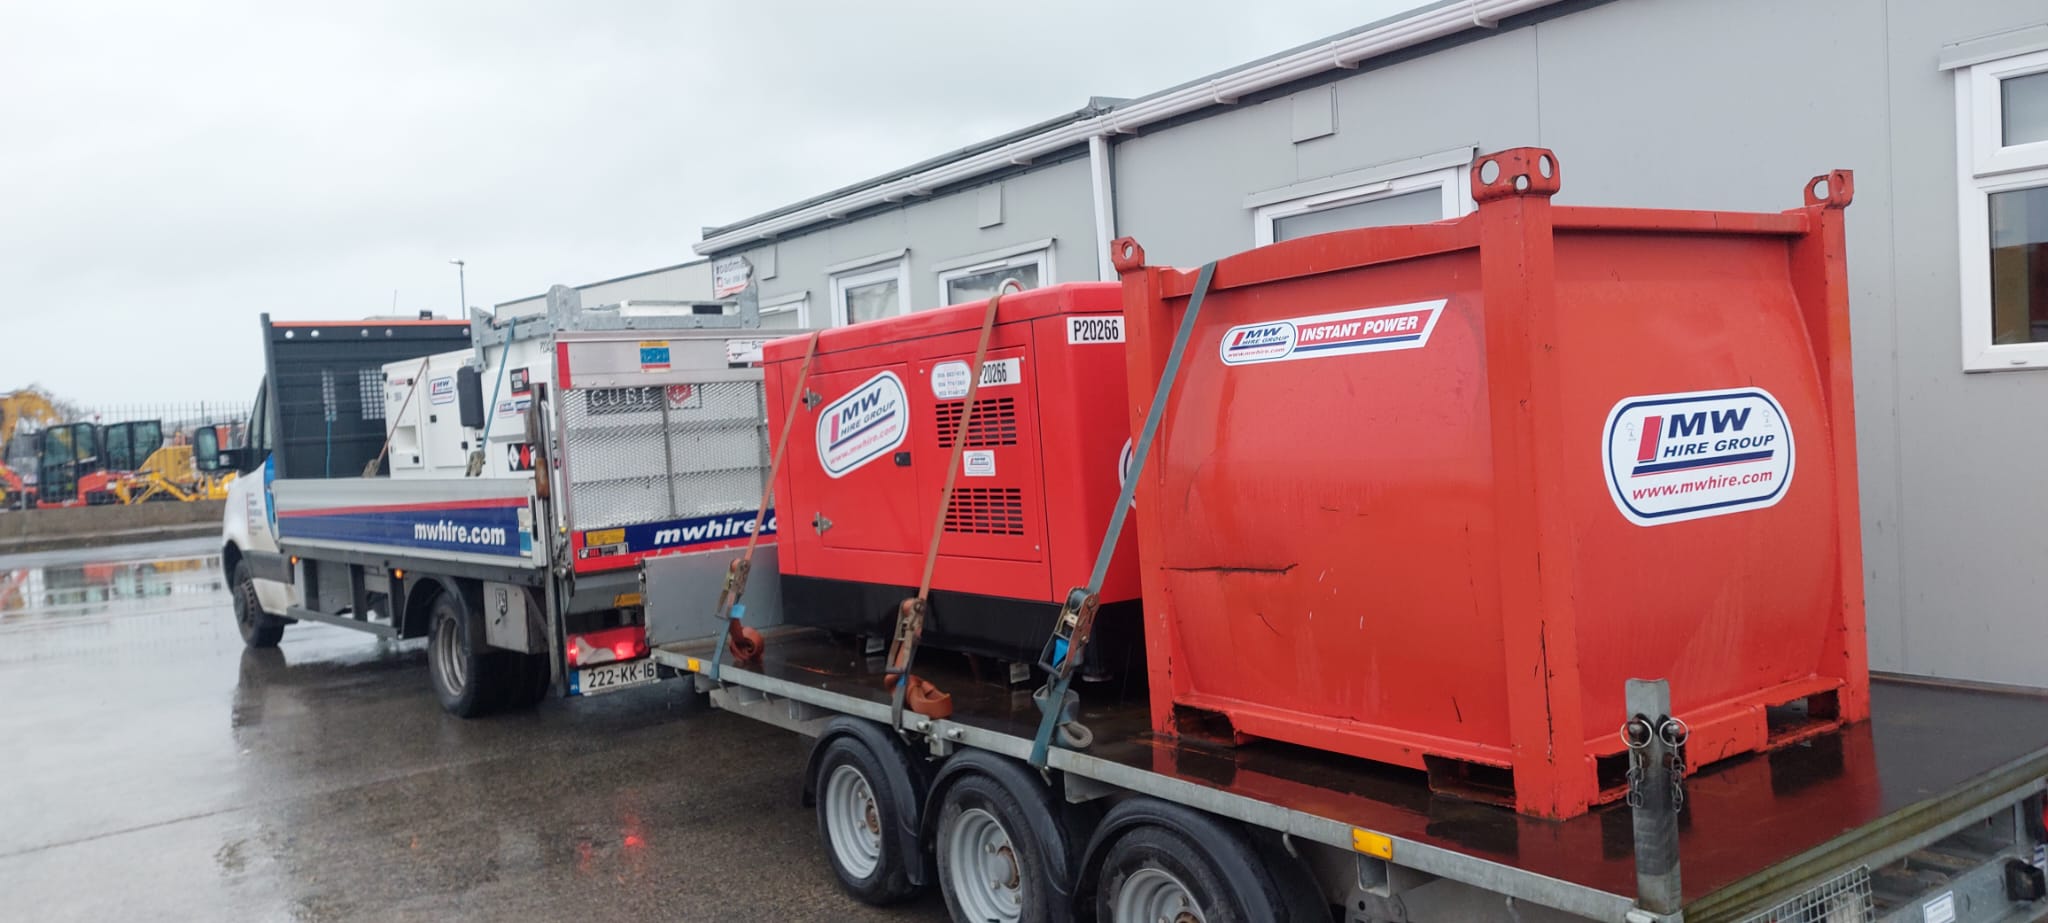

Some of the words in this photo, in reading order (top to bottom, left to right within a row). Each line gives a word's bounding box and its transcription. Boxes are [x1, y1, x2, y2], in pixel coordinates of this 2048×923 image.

[1073, 319, 1119, 341] P20266
[1242, 338, 1261, 346] HIRE
[1262, 335, 1289, 344] GROUP
[1245, 326, 1282, 339] MW
[1301, 322, 1361, 342] INSTANT
[1363, 316, 1419, 335] POWER
[980, 361, 1007, 384] 20266
[840, 419, 861, 437] HIRE
[863, 399, 896, 424] GROUP
[842, 387, 882, 424] MW
[1668, 406, 1752, 439] MW
[1663, 441, 1709, 458] HIRE
[1714, 434, 1775, 452] GROUP
[1632, 471, 1773, 501] www.mwhire.com
[414, 519, 506, 546] mwhire.com
[588, 662, 655, 689] 222-KK-16
